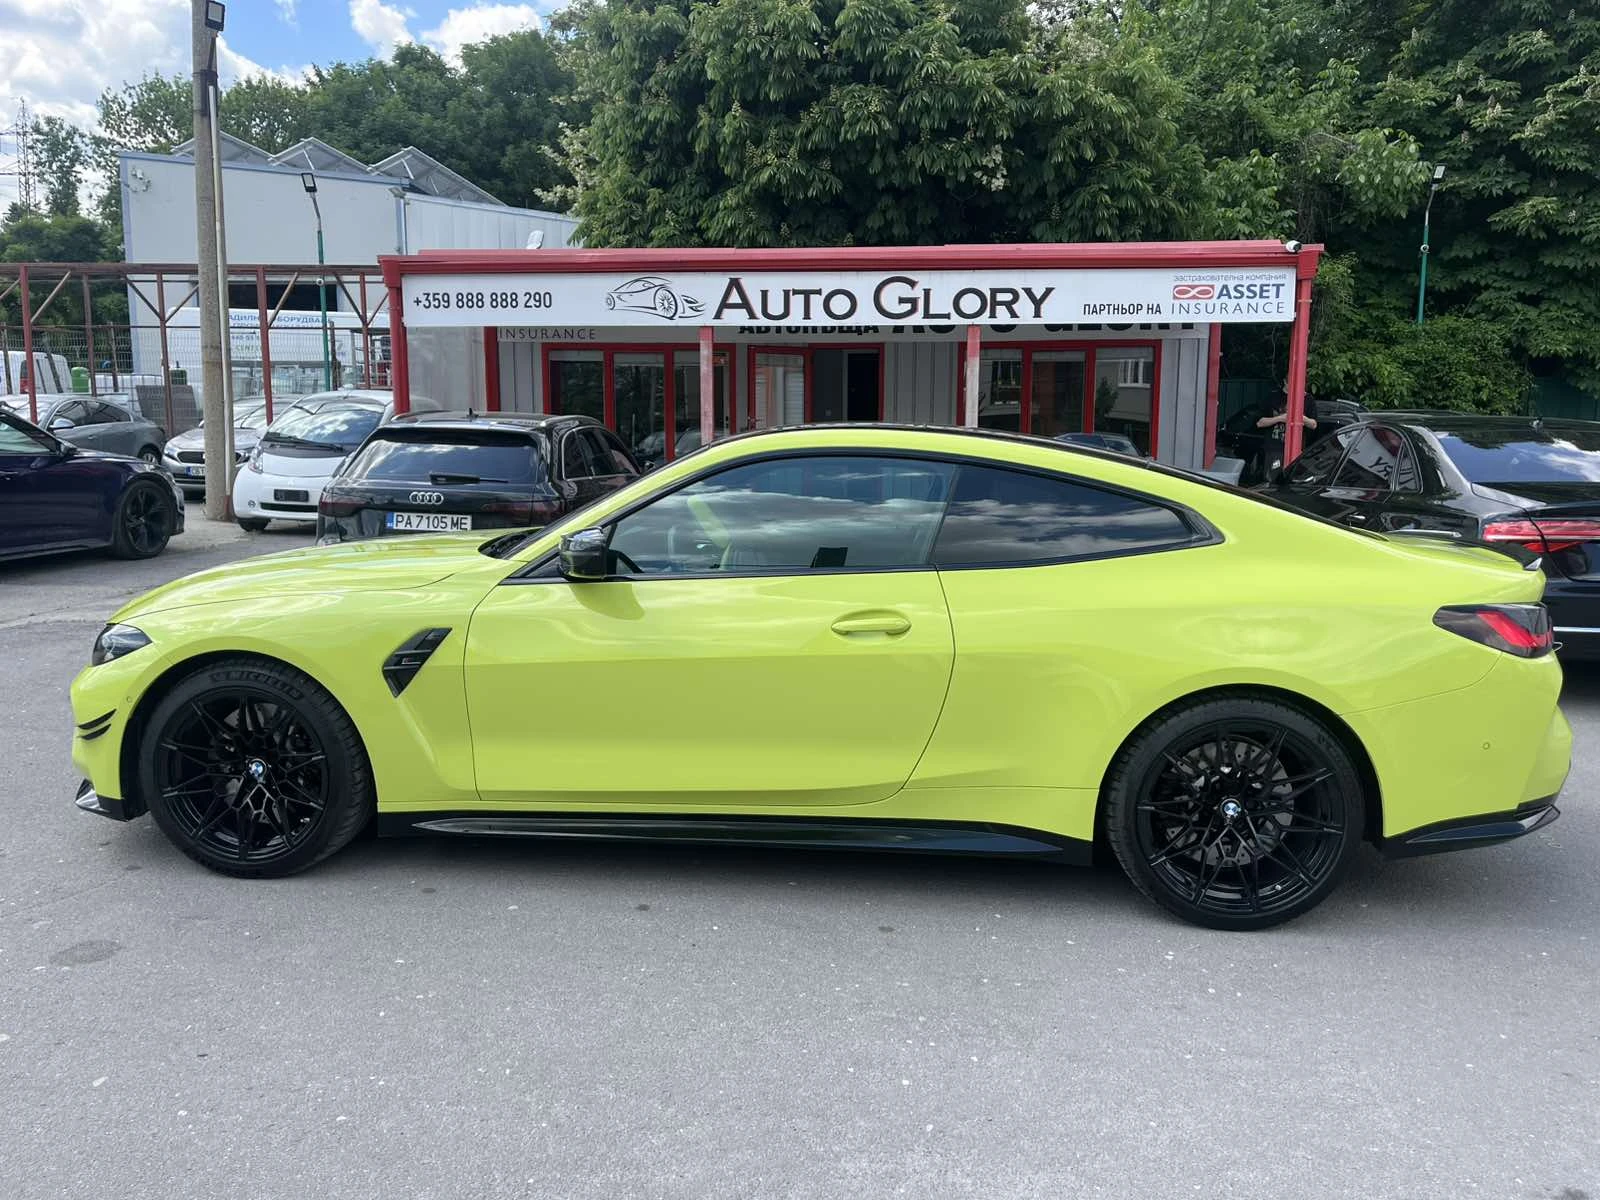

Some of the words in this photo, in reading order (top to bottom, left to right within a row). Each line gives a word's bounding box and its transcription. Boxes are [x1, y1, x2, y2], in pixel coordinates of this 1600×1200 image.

[712, 277, 858, 320] AUTO
[873, 275, 1056, 319] GLORY
[1216, 283, 1285, 299] ASSET
[413, 292, 450, 309] +359
[456, 292, 485, 309] 888
[490, 292, 519, 309] 888
[523, 292, 552, 309] 290
[1083, 303, 1143, 315] ПАРТНЬОР
[1147, 303, 1162, 315] НА
[1171, 302, 1285, 314] INSURANCE
[499, 327, 597, 340] INSURANCE
